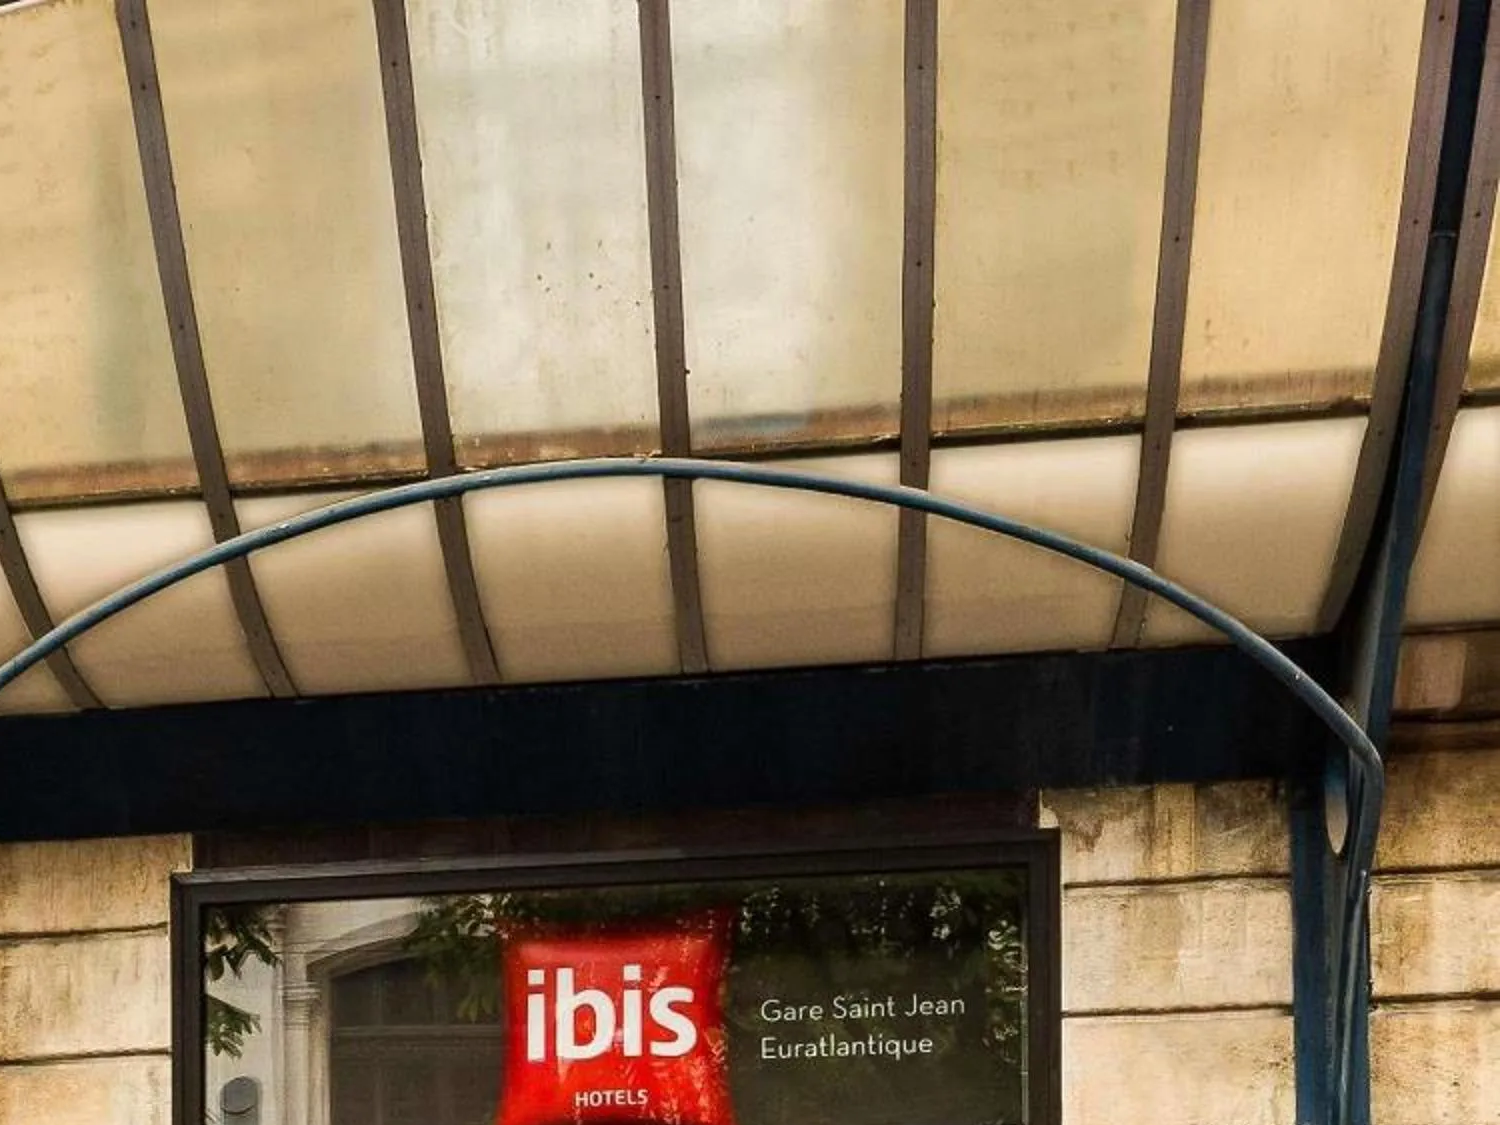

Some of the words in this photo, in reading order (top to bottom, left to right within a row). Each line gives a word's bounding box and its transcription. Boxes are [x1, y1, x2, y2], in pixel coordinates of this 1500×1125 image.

[526, 964, 698, 1063] ibis
[760, 998, 824, 1022] Gare
[832, 995, 896, 1019] Saint
[904, 993, 966, 1017] Jean
[760, 1033, 934, 1060] Euratlantique
[575, 1089, 649, 1108] HOTELS
